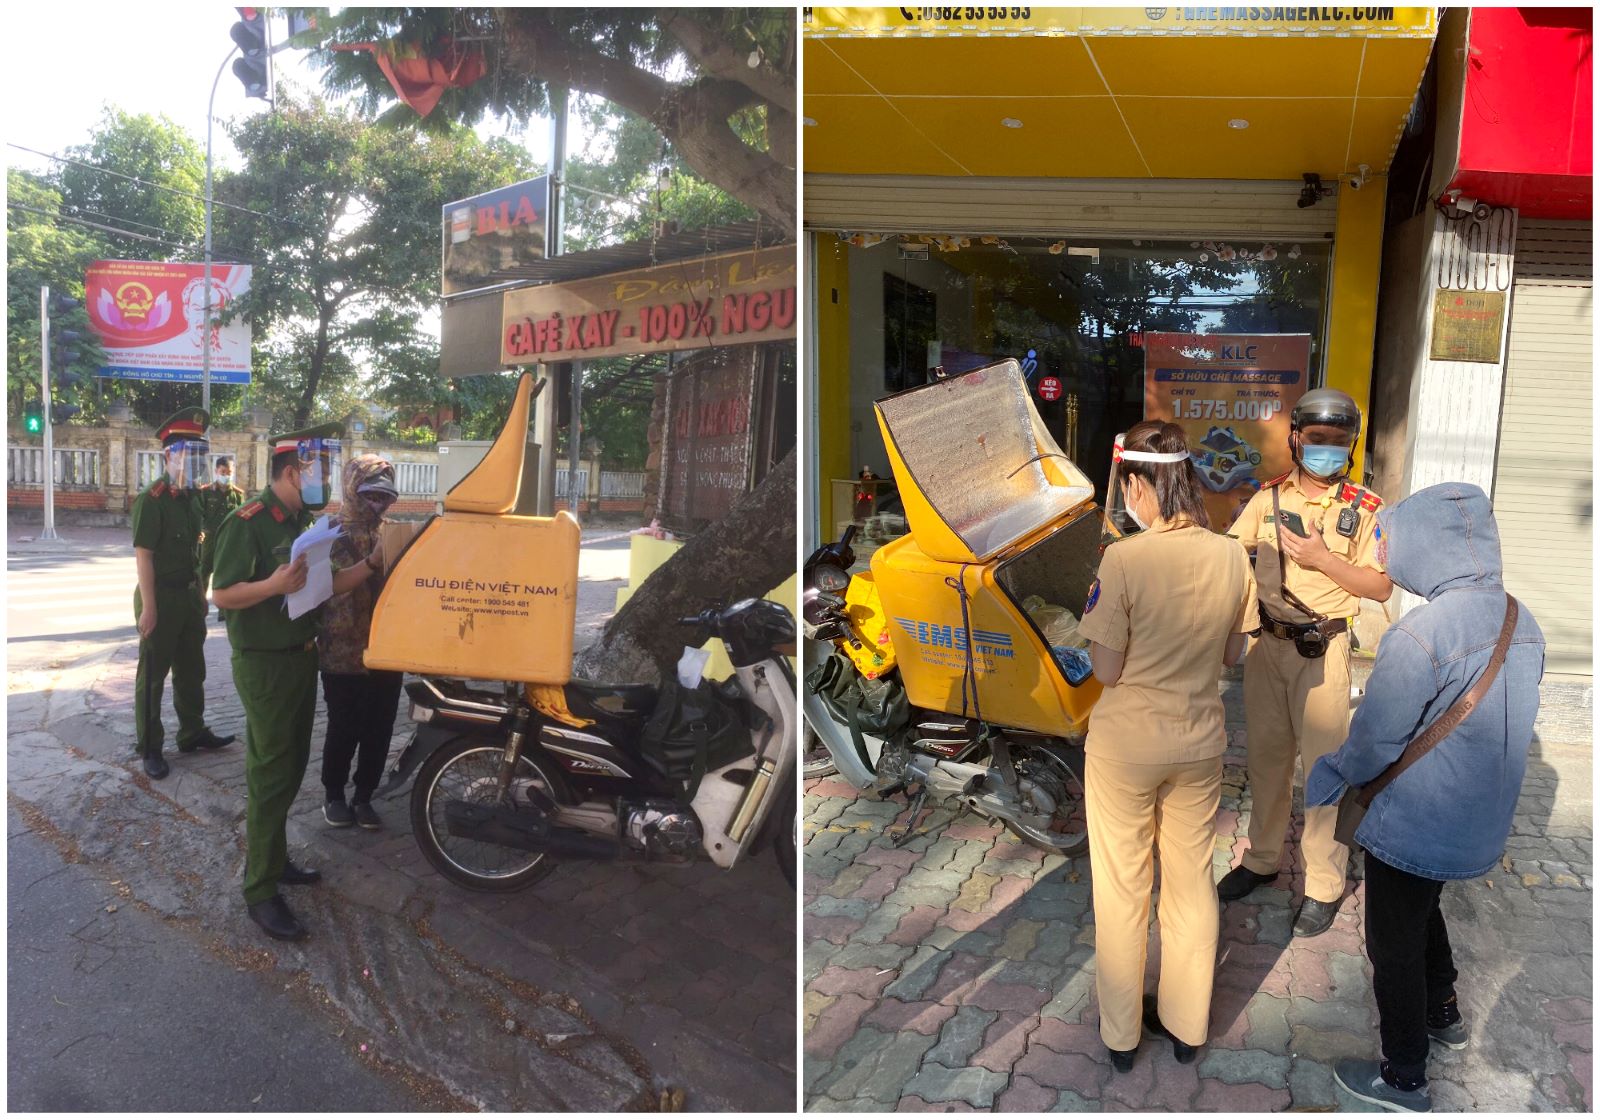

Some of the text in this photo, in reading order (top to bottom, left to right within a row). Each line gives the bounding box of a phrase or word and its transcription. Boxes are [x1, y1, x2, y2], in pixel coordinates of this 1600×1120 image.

[476, 196, 538, 237] BIA
[564, 309, 619, 350] XAY
[639, 297, 715, 344] 100%
[1220, 345, 1257, 360] KLC
[1232, 373, 1281, 382] MASSAGE
[415, 577, 558, 597] BƯU ĐIỆN VIỆT NAM
[440, 595, 455, 603] Call
[484, 598, 501, 606] 1900
[918, 621, 968, 651] EMS
[994, 647, 1014, 659] NAM
